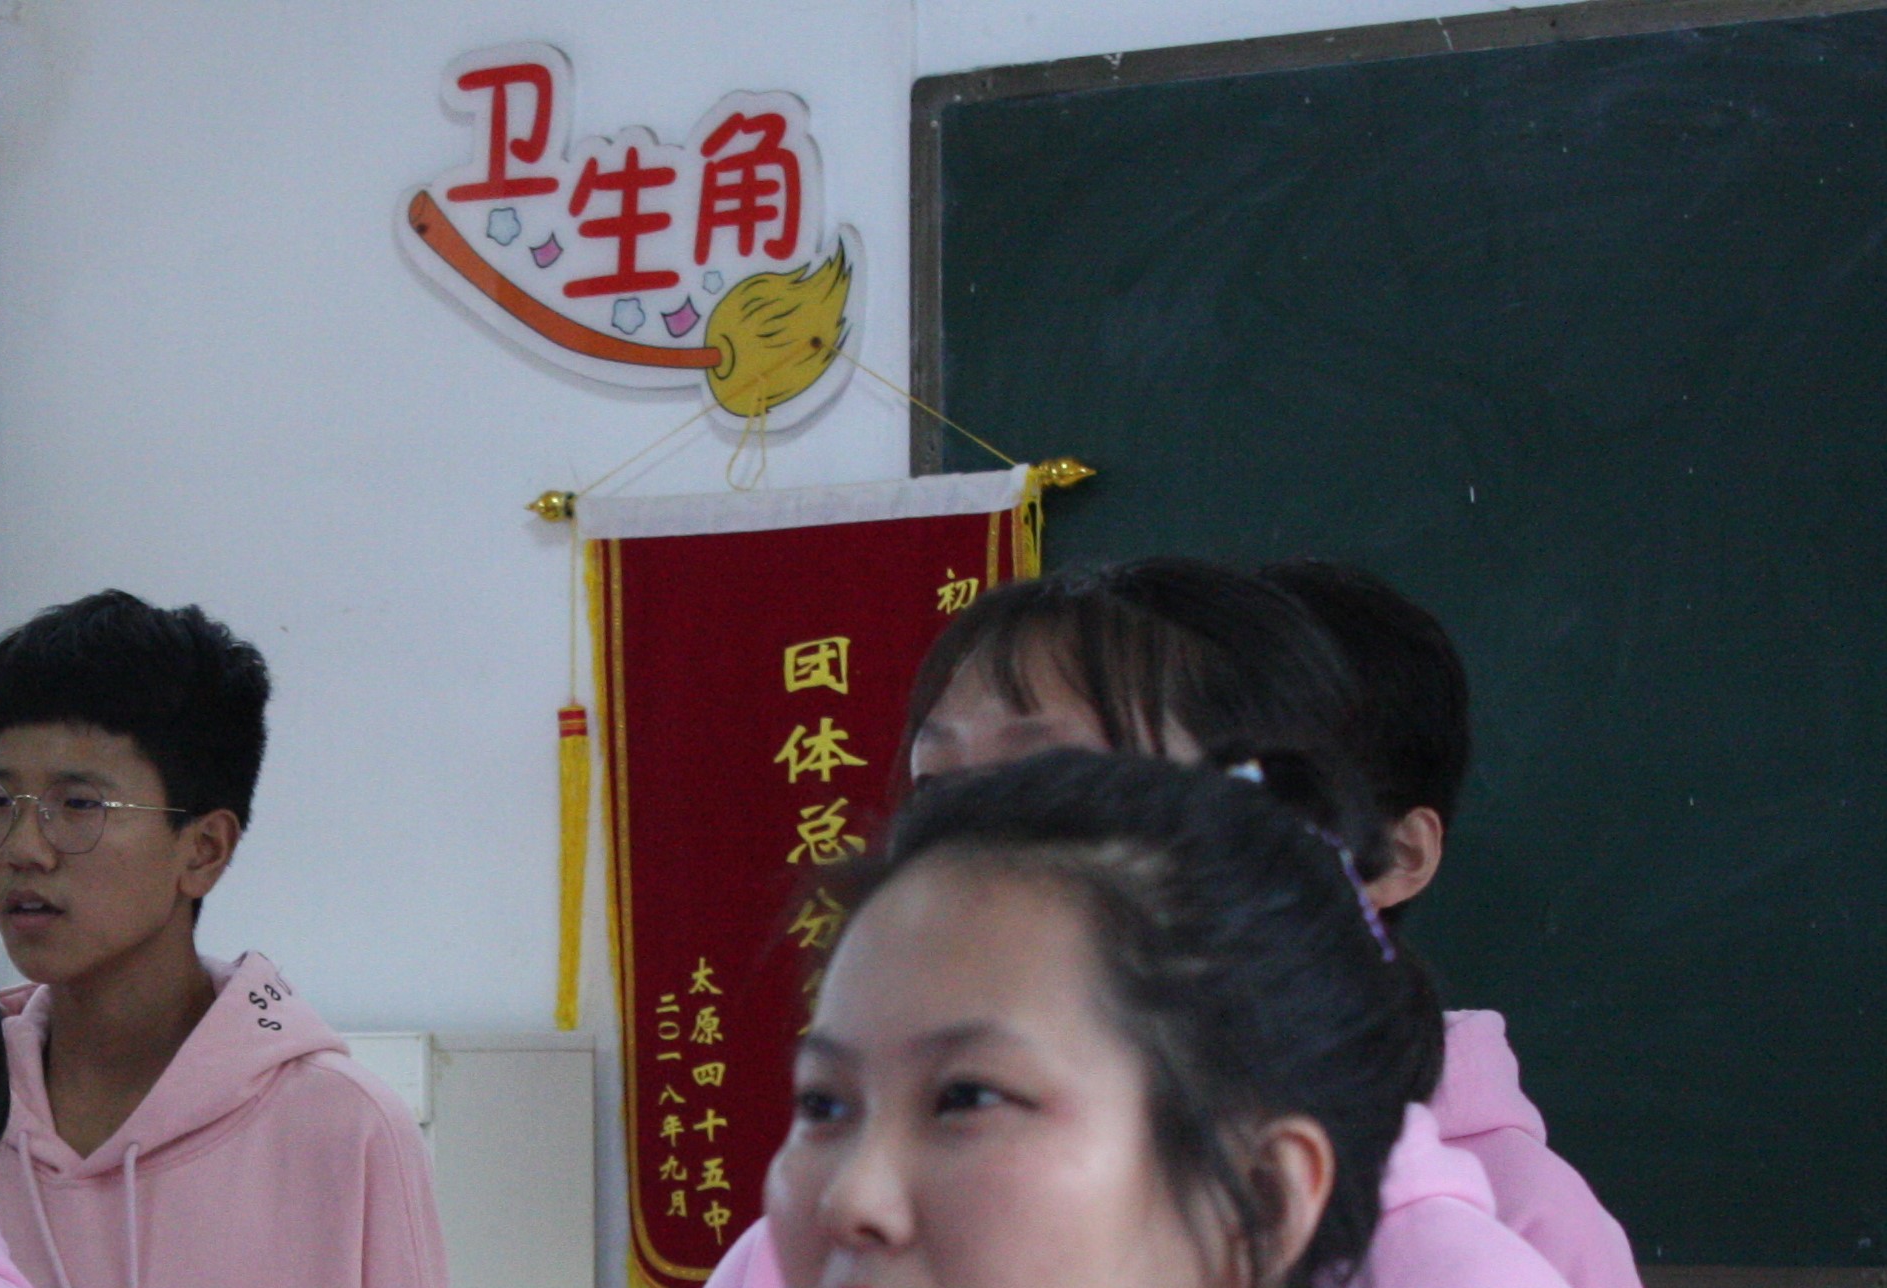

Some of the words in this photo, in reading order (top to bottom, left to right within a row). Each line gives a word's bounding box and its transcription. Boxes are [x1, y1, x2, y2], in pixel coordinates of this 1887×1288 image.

[446, 63, 802, 299] 卫生角
[937, 569, 979, 614] 初
[688, 957, 732, 1245] 太原四十五中
